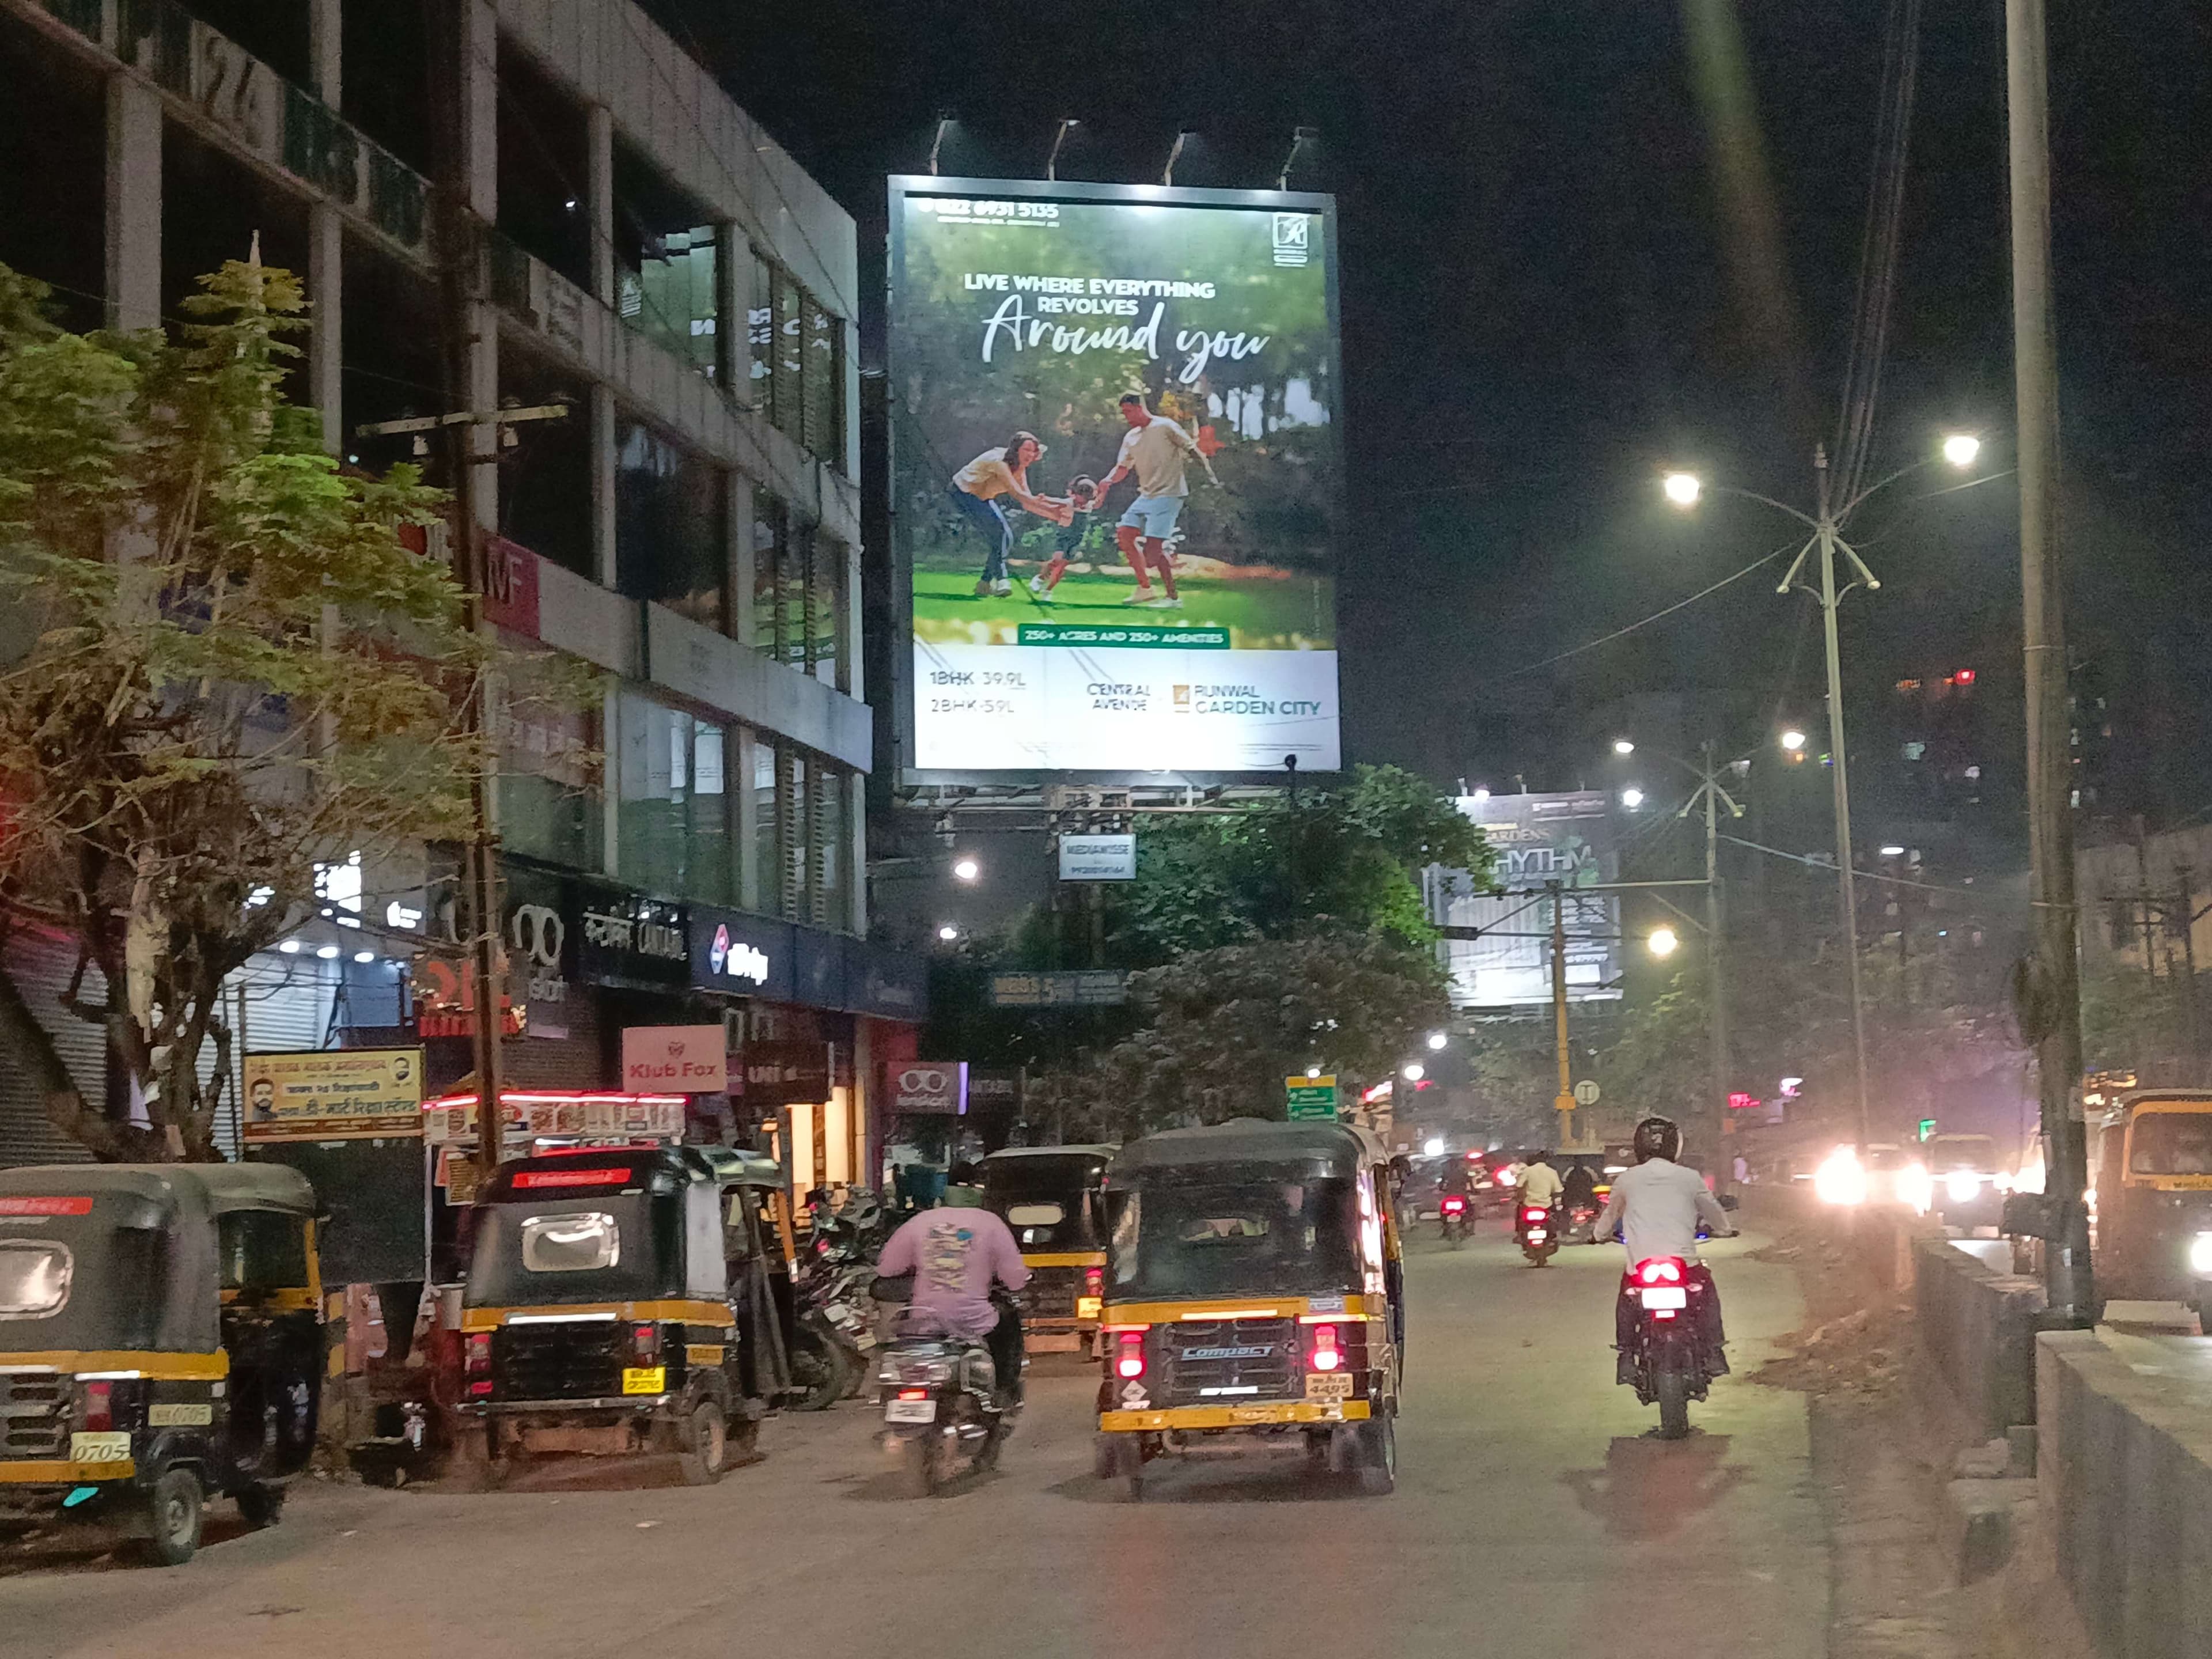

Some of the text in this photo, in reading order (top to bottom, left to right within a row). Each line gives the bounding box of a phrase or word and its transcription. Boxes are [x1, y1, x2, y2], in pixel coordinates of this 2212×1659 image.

[965, 274, 1216, 299] LIVE WHERE EVERYTHING
[1037, 297, 1139, 316] REVOLVES
[982, 294, 1270, 384] Around you
[930, 671, 975, 686] 1BHK
[1086, 683, 1151, 696] CENTRAL
[931, 699, 978, 713] 2BHK
[1195, 700, 1321, 715] GARDEN CITY
[630, 1062, 717, 1078] Klub Fox
[74, 1444, 130, 1461] 0705
